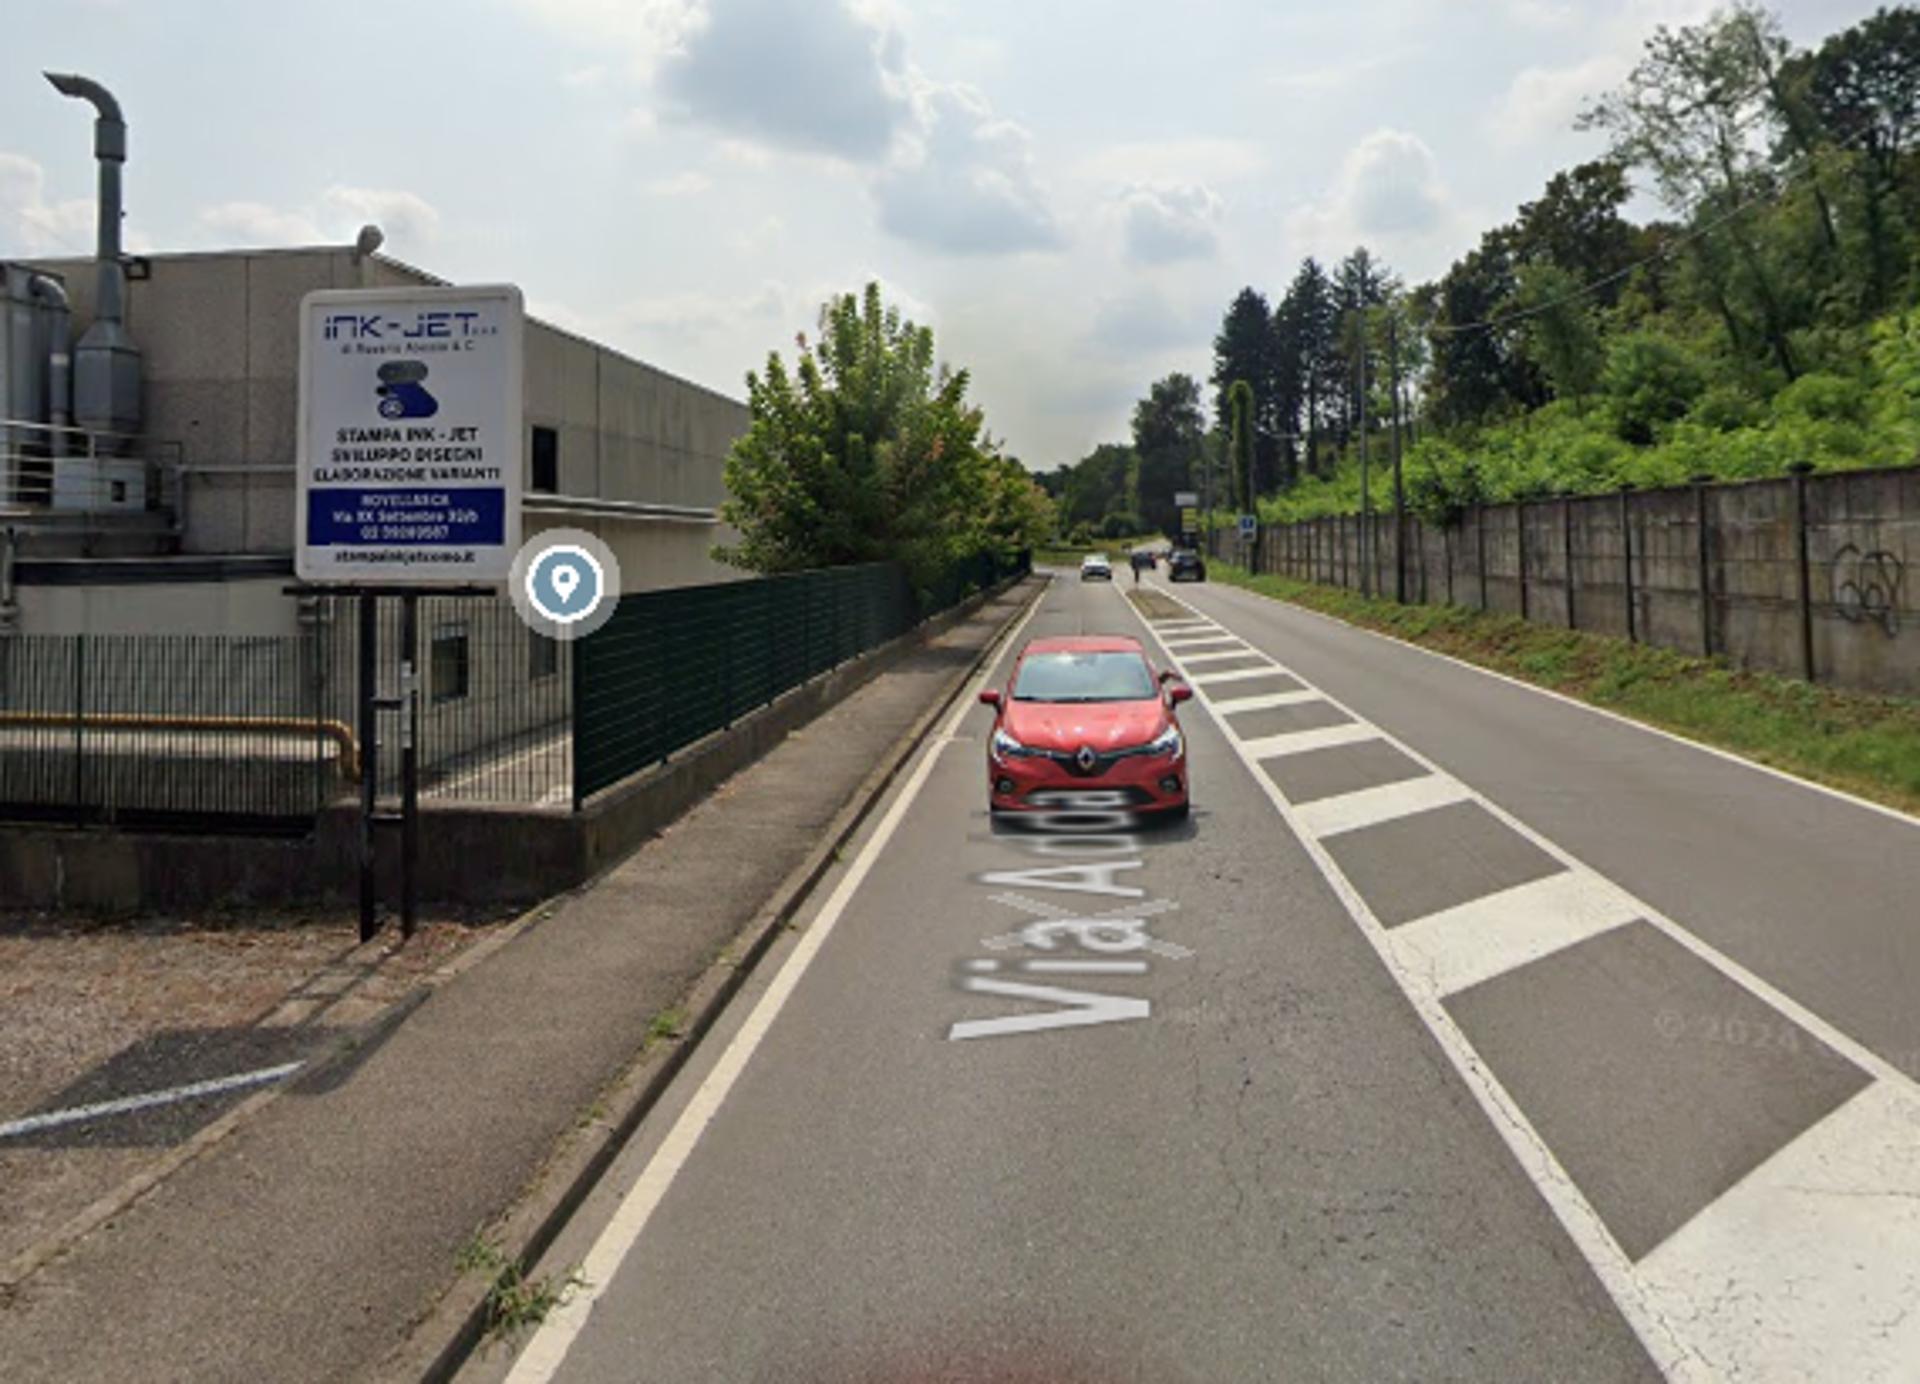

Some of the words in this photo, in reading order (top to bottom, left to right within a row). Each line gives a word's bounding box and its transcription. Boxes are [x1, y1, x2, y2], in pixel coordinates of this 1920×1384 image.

[337, 427, 401, 443] STAMPA
[449, 427, 478, 441] JET
[332, 448, 411, 462] SVILUPPO
[415, 447, 482, 461] DISEGNI
[313, 468, 425, 482] ELABORAZIONE
[431, 467, 500, 480] VARIANTI
[333, 511, 352, 523] Via
